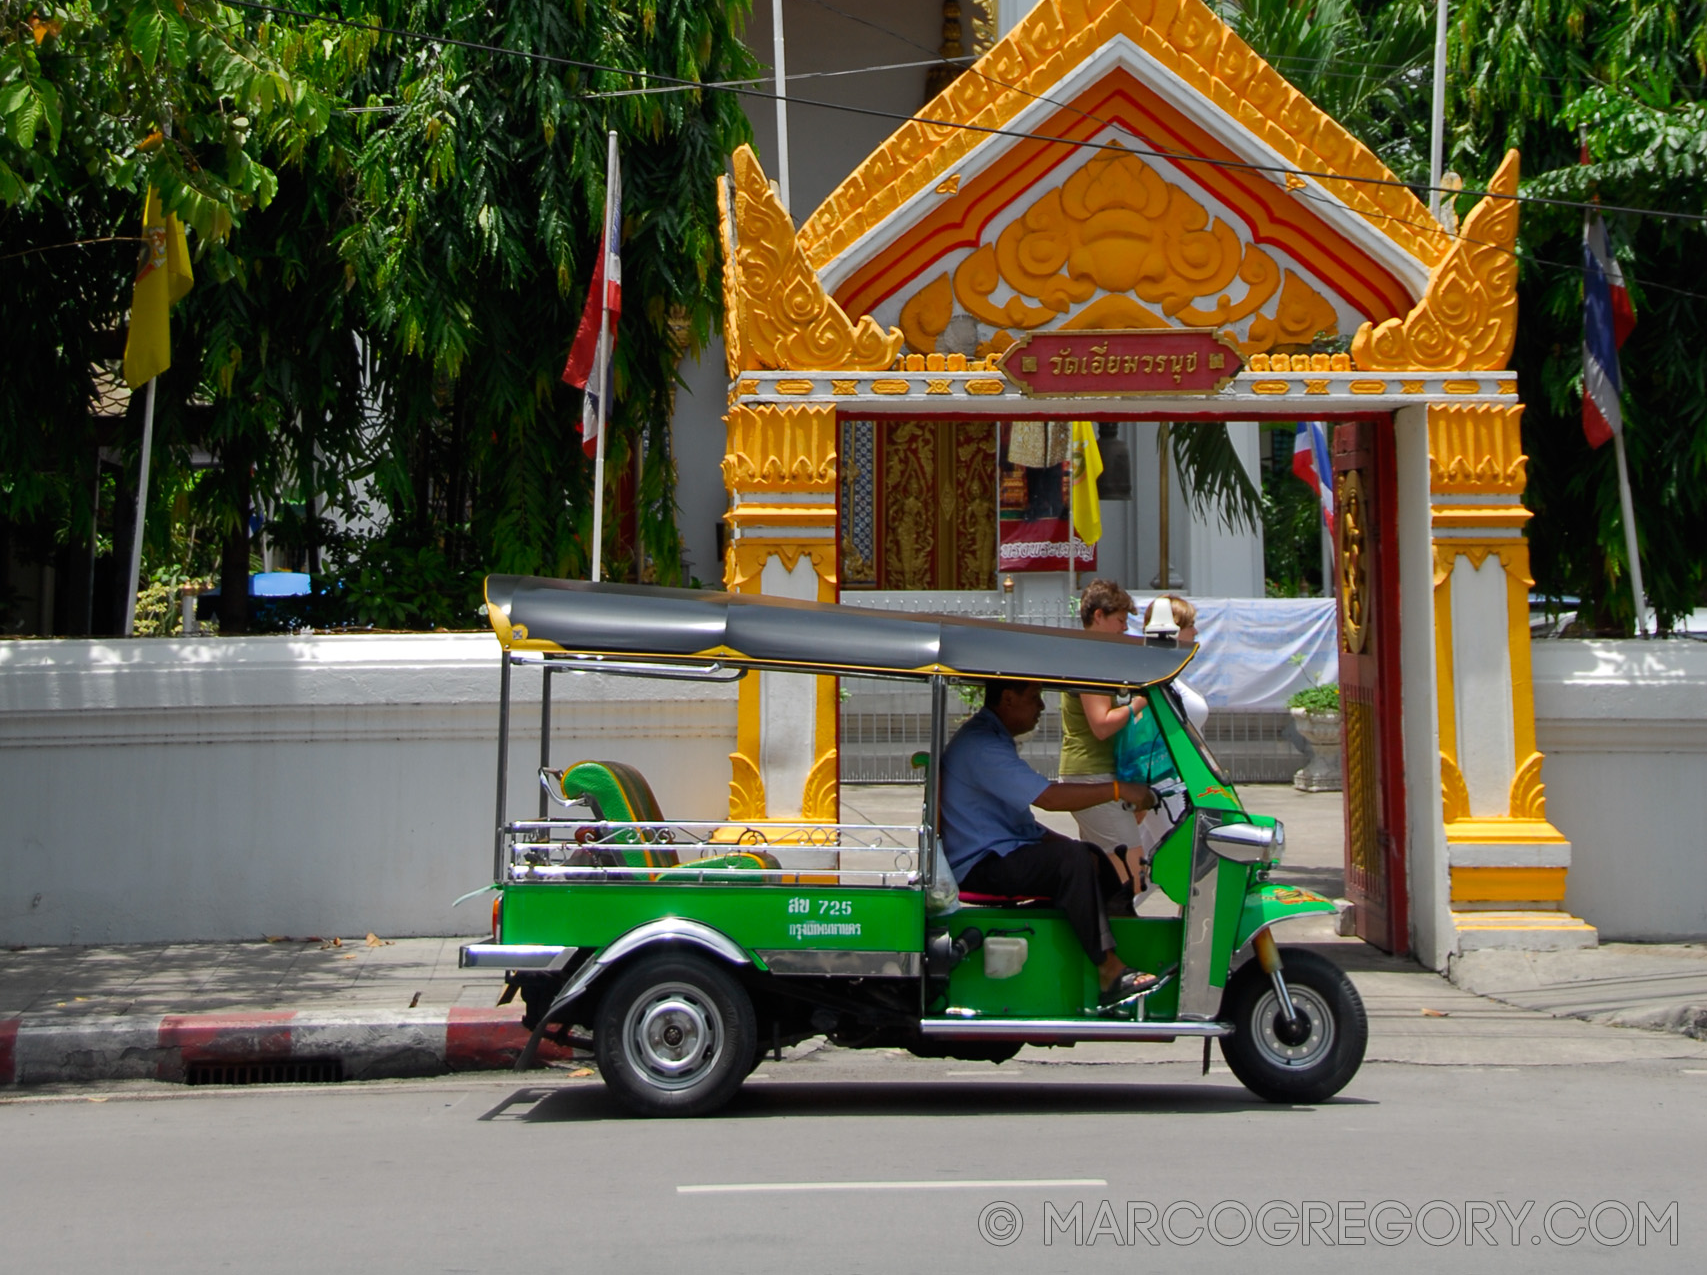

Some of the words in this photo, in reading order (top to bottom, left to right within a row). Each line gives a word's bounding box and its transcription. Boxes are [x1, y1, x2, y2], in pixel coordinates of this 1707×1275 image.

[1049, 340, 1198, 384] วัดเอี่ยมวรนุช
[818, 900, 853, 915] 725
